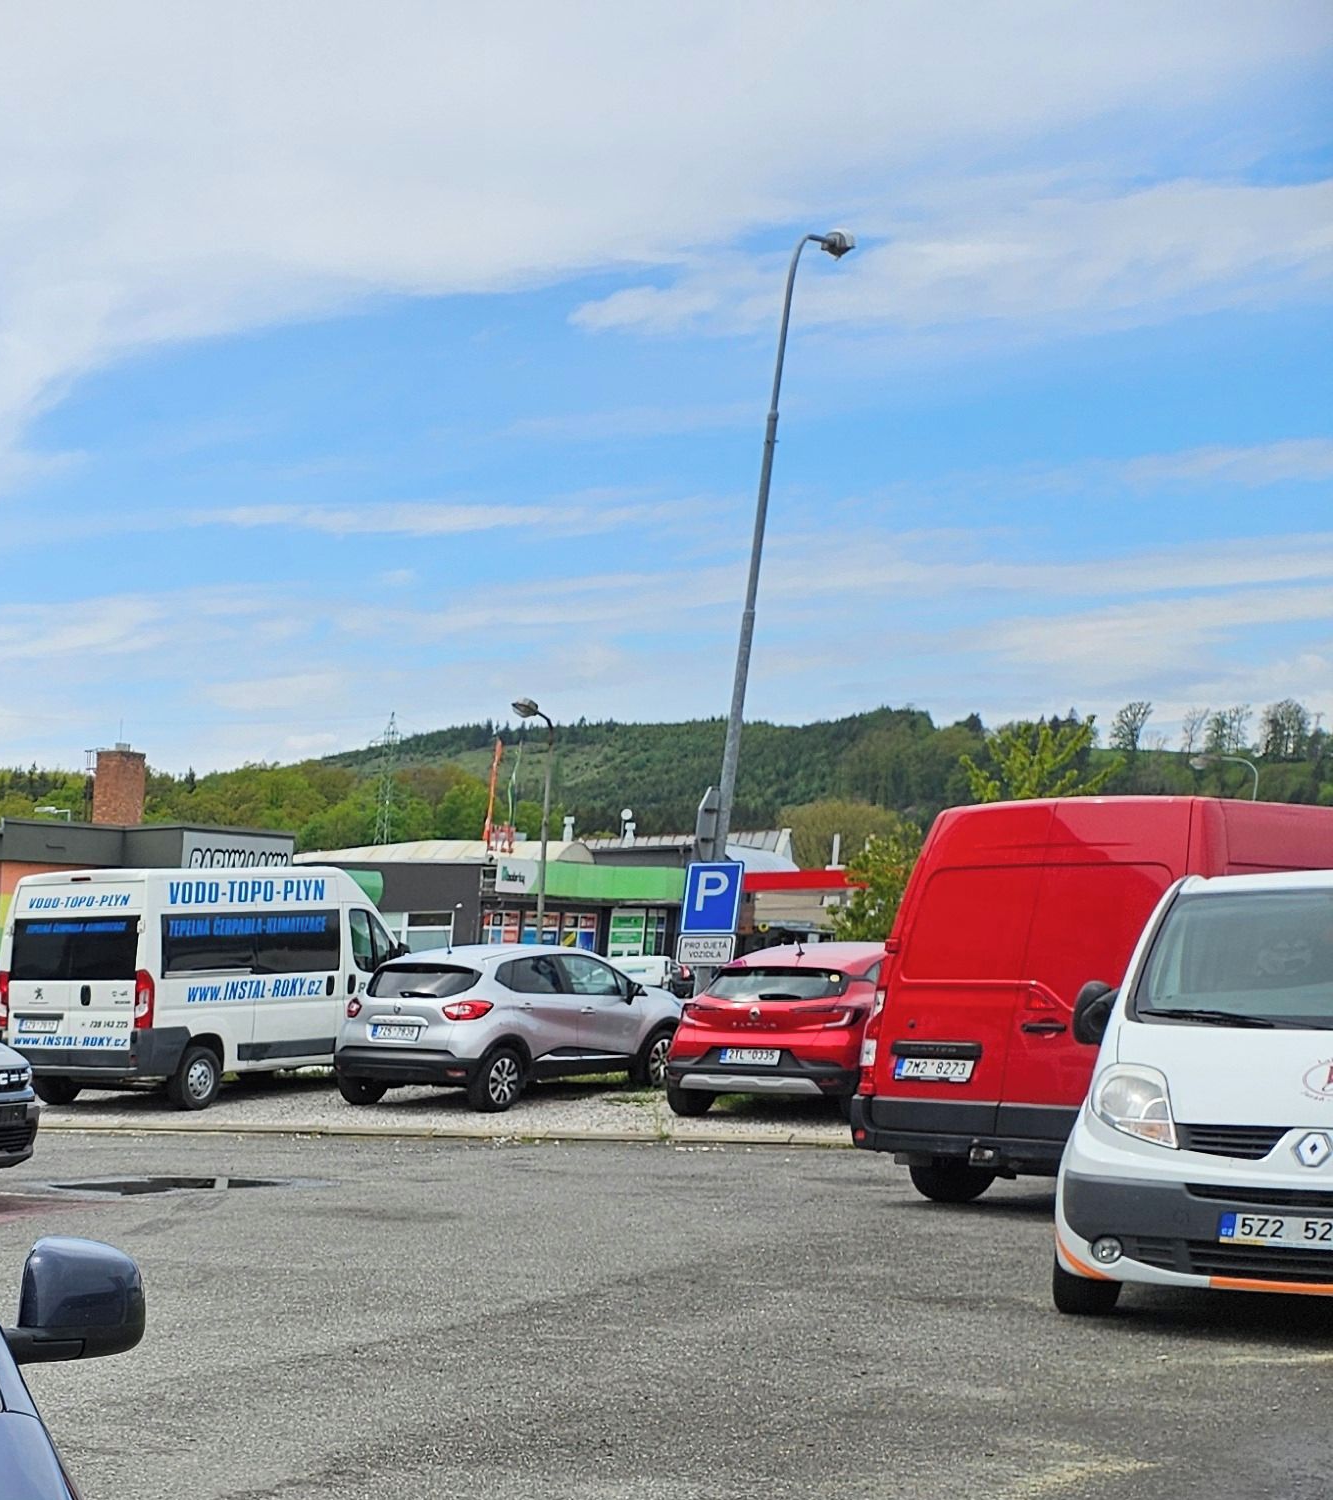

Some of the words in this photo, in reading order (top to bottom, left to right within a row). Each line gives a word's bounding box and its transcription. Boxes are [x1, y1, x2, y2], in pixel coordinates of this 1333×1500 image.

[28, 893, 131, 909] VODO-TOPO-PLYN
[169, 878, 326, 904] VODO-TOPO-PLYN
[695, 871, 730, 912] P
[168, 917, 211, 937] TEPELNÁ
[688, 951, 722, 959] VOZIDLA
[187, 977, 323, 1003] www.INSTAL-ROKY.cz
[728, 1049, 745, 1060] 2TL
[751, 1050, 776, 1060] 0335
[905, 1060, 928, 1074] 7M2
[935, 1061, 967, 1076] 8273
[1240, 1217, 1285, 1239] 5Z2
[1303, 1221, 1333, 1242] 52
